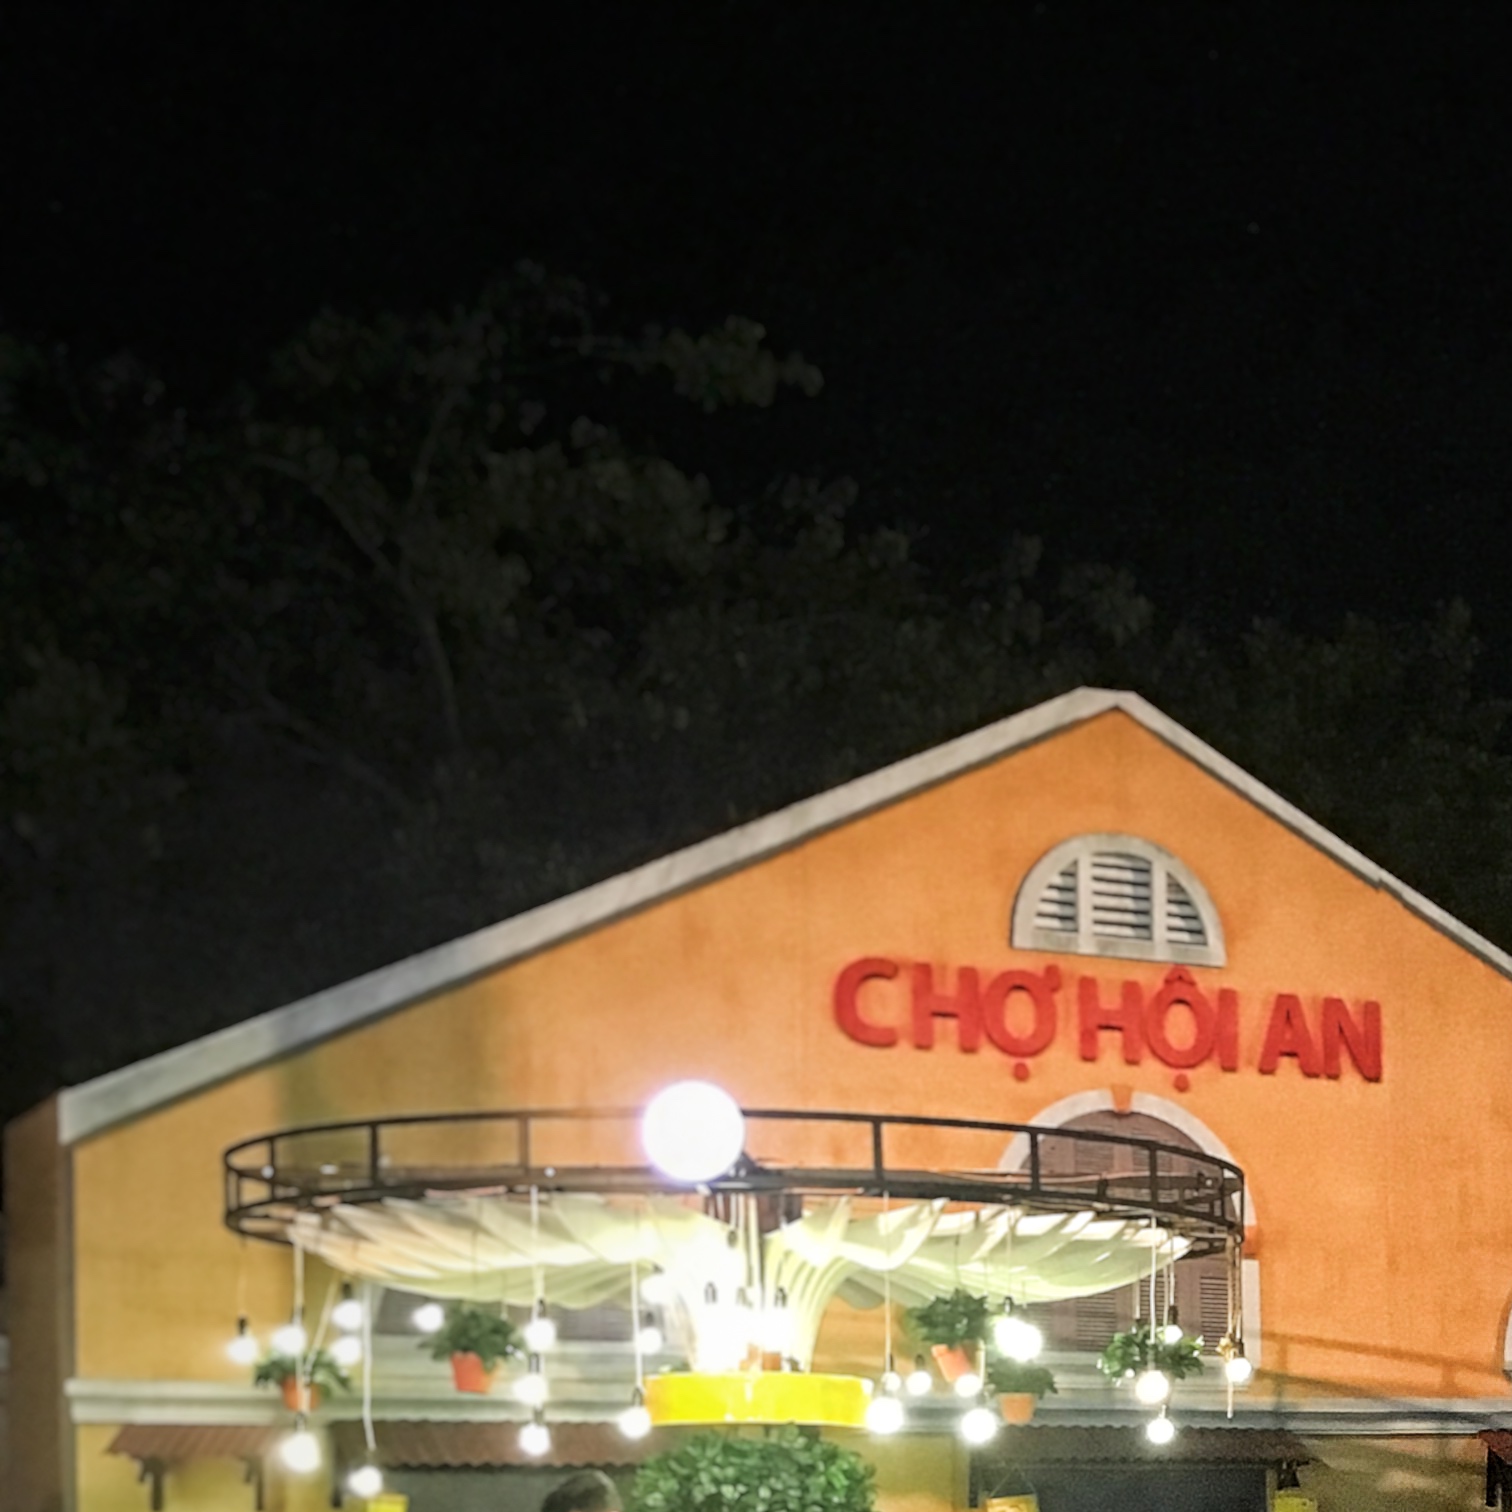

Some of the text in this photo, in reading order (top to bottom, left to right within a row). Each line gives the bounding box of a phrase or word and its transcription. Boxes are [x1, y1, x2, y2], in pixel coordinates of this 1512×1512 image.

[832, 956, 1383, 1092] CHỢ HỘI AN
